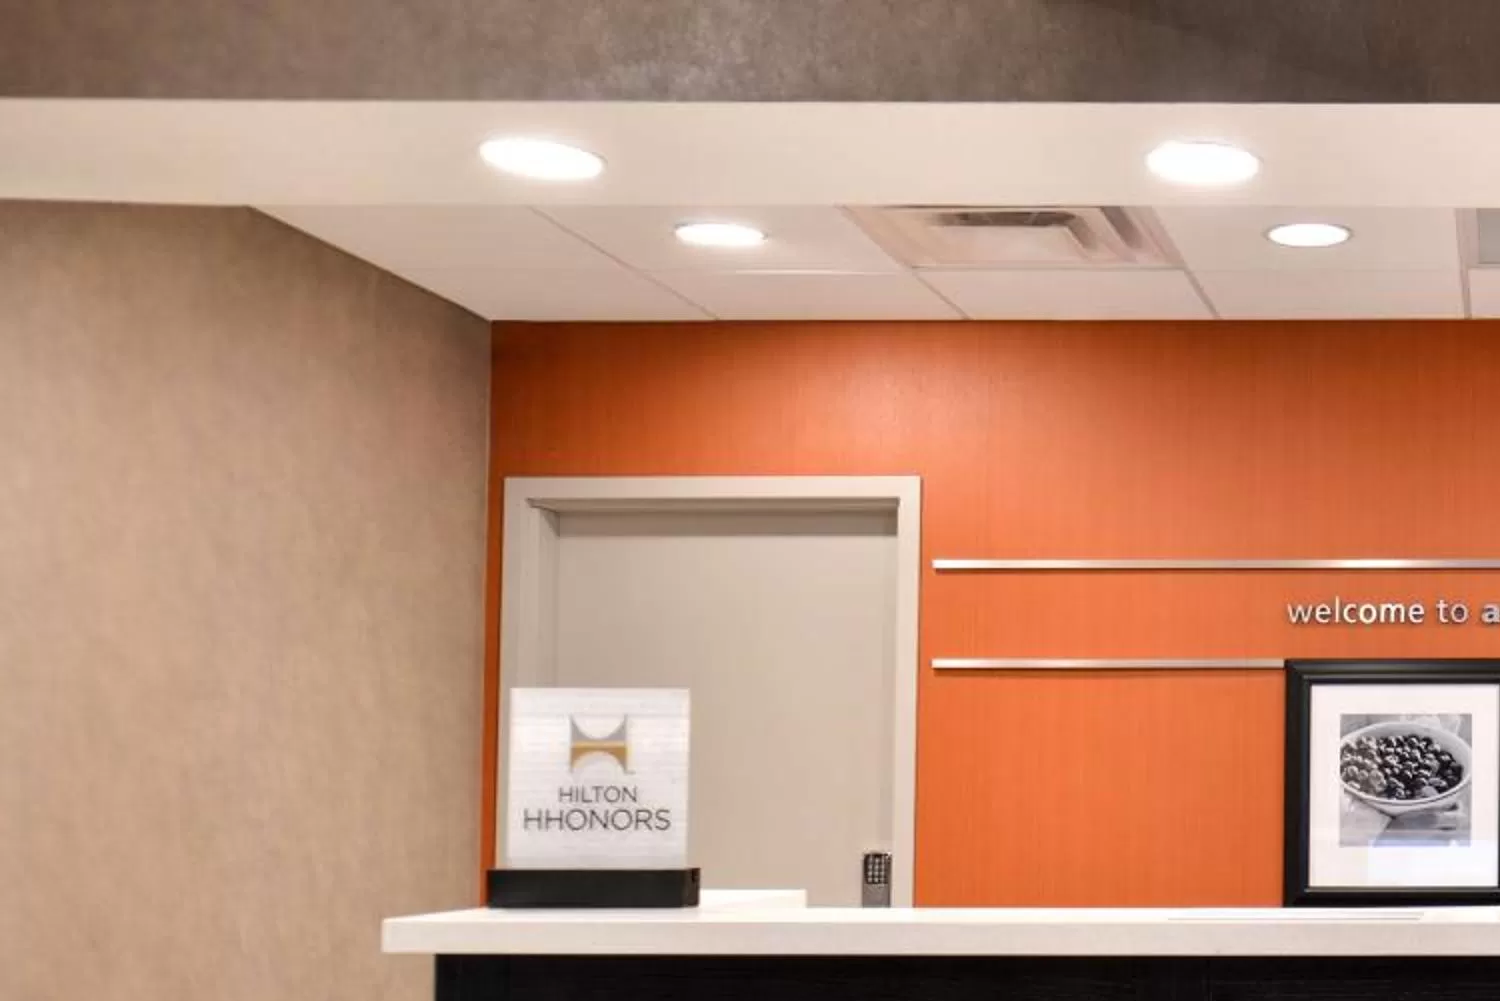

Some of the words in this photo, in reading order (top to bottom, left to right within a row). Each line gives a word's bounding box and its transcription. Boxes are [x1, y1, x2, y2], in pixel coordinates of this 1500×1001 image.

[1287, 596, 1425, 624] welcome
[1436, 600, 1469, 624] to
[558, 785, 638, 803] HILTON
[523, 808, 672, 831] HHONORS
